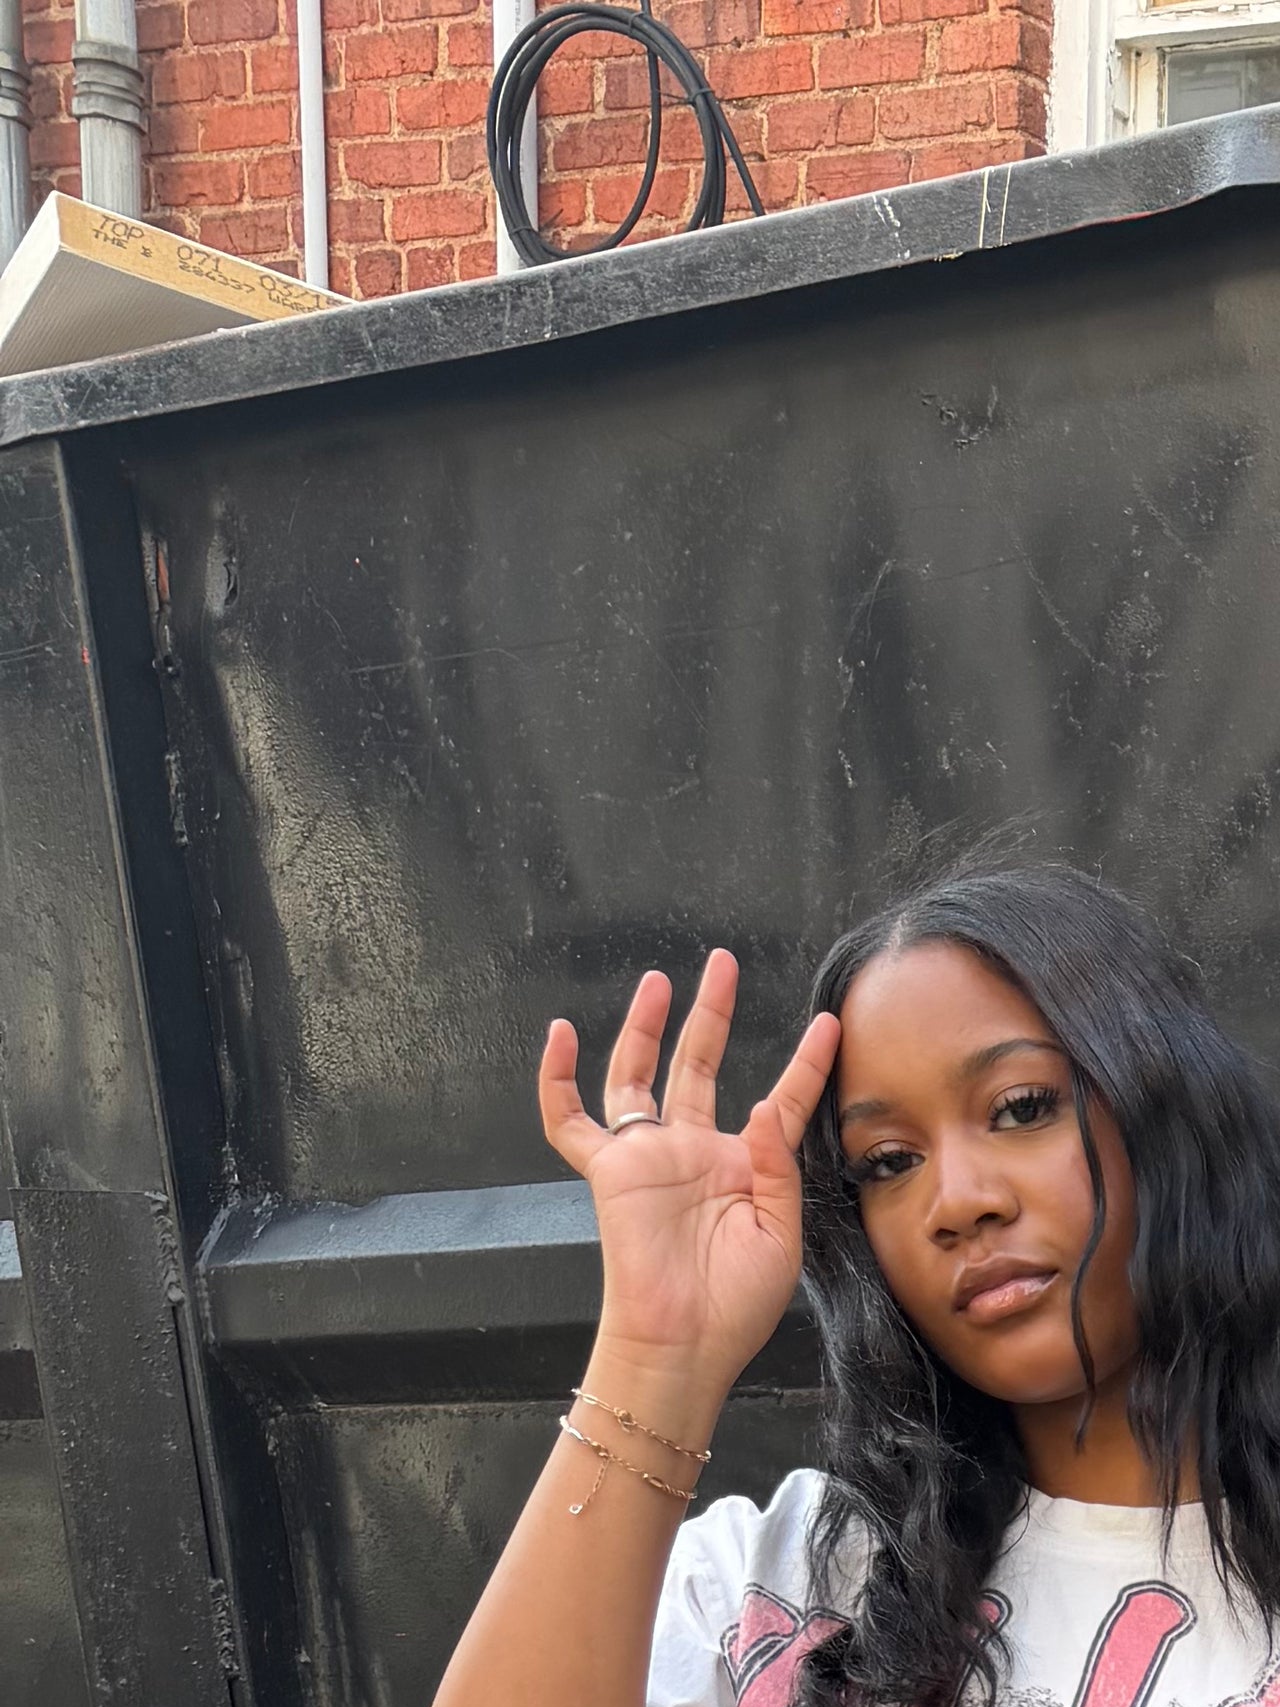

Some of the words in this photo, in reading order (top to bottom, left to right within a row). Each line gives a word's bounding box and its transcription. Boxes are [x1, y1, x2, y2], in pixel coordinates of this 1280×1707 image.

[91, 228, 129, 250] THE
[99, 213, 145, 240] TOP
[176, 244, 222, 274] 071
